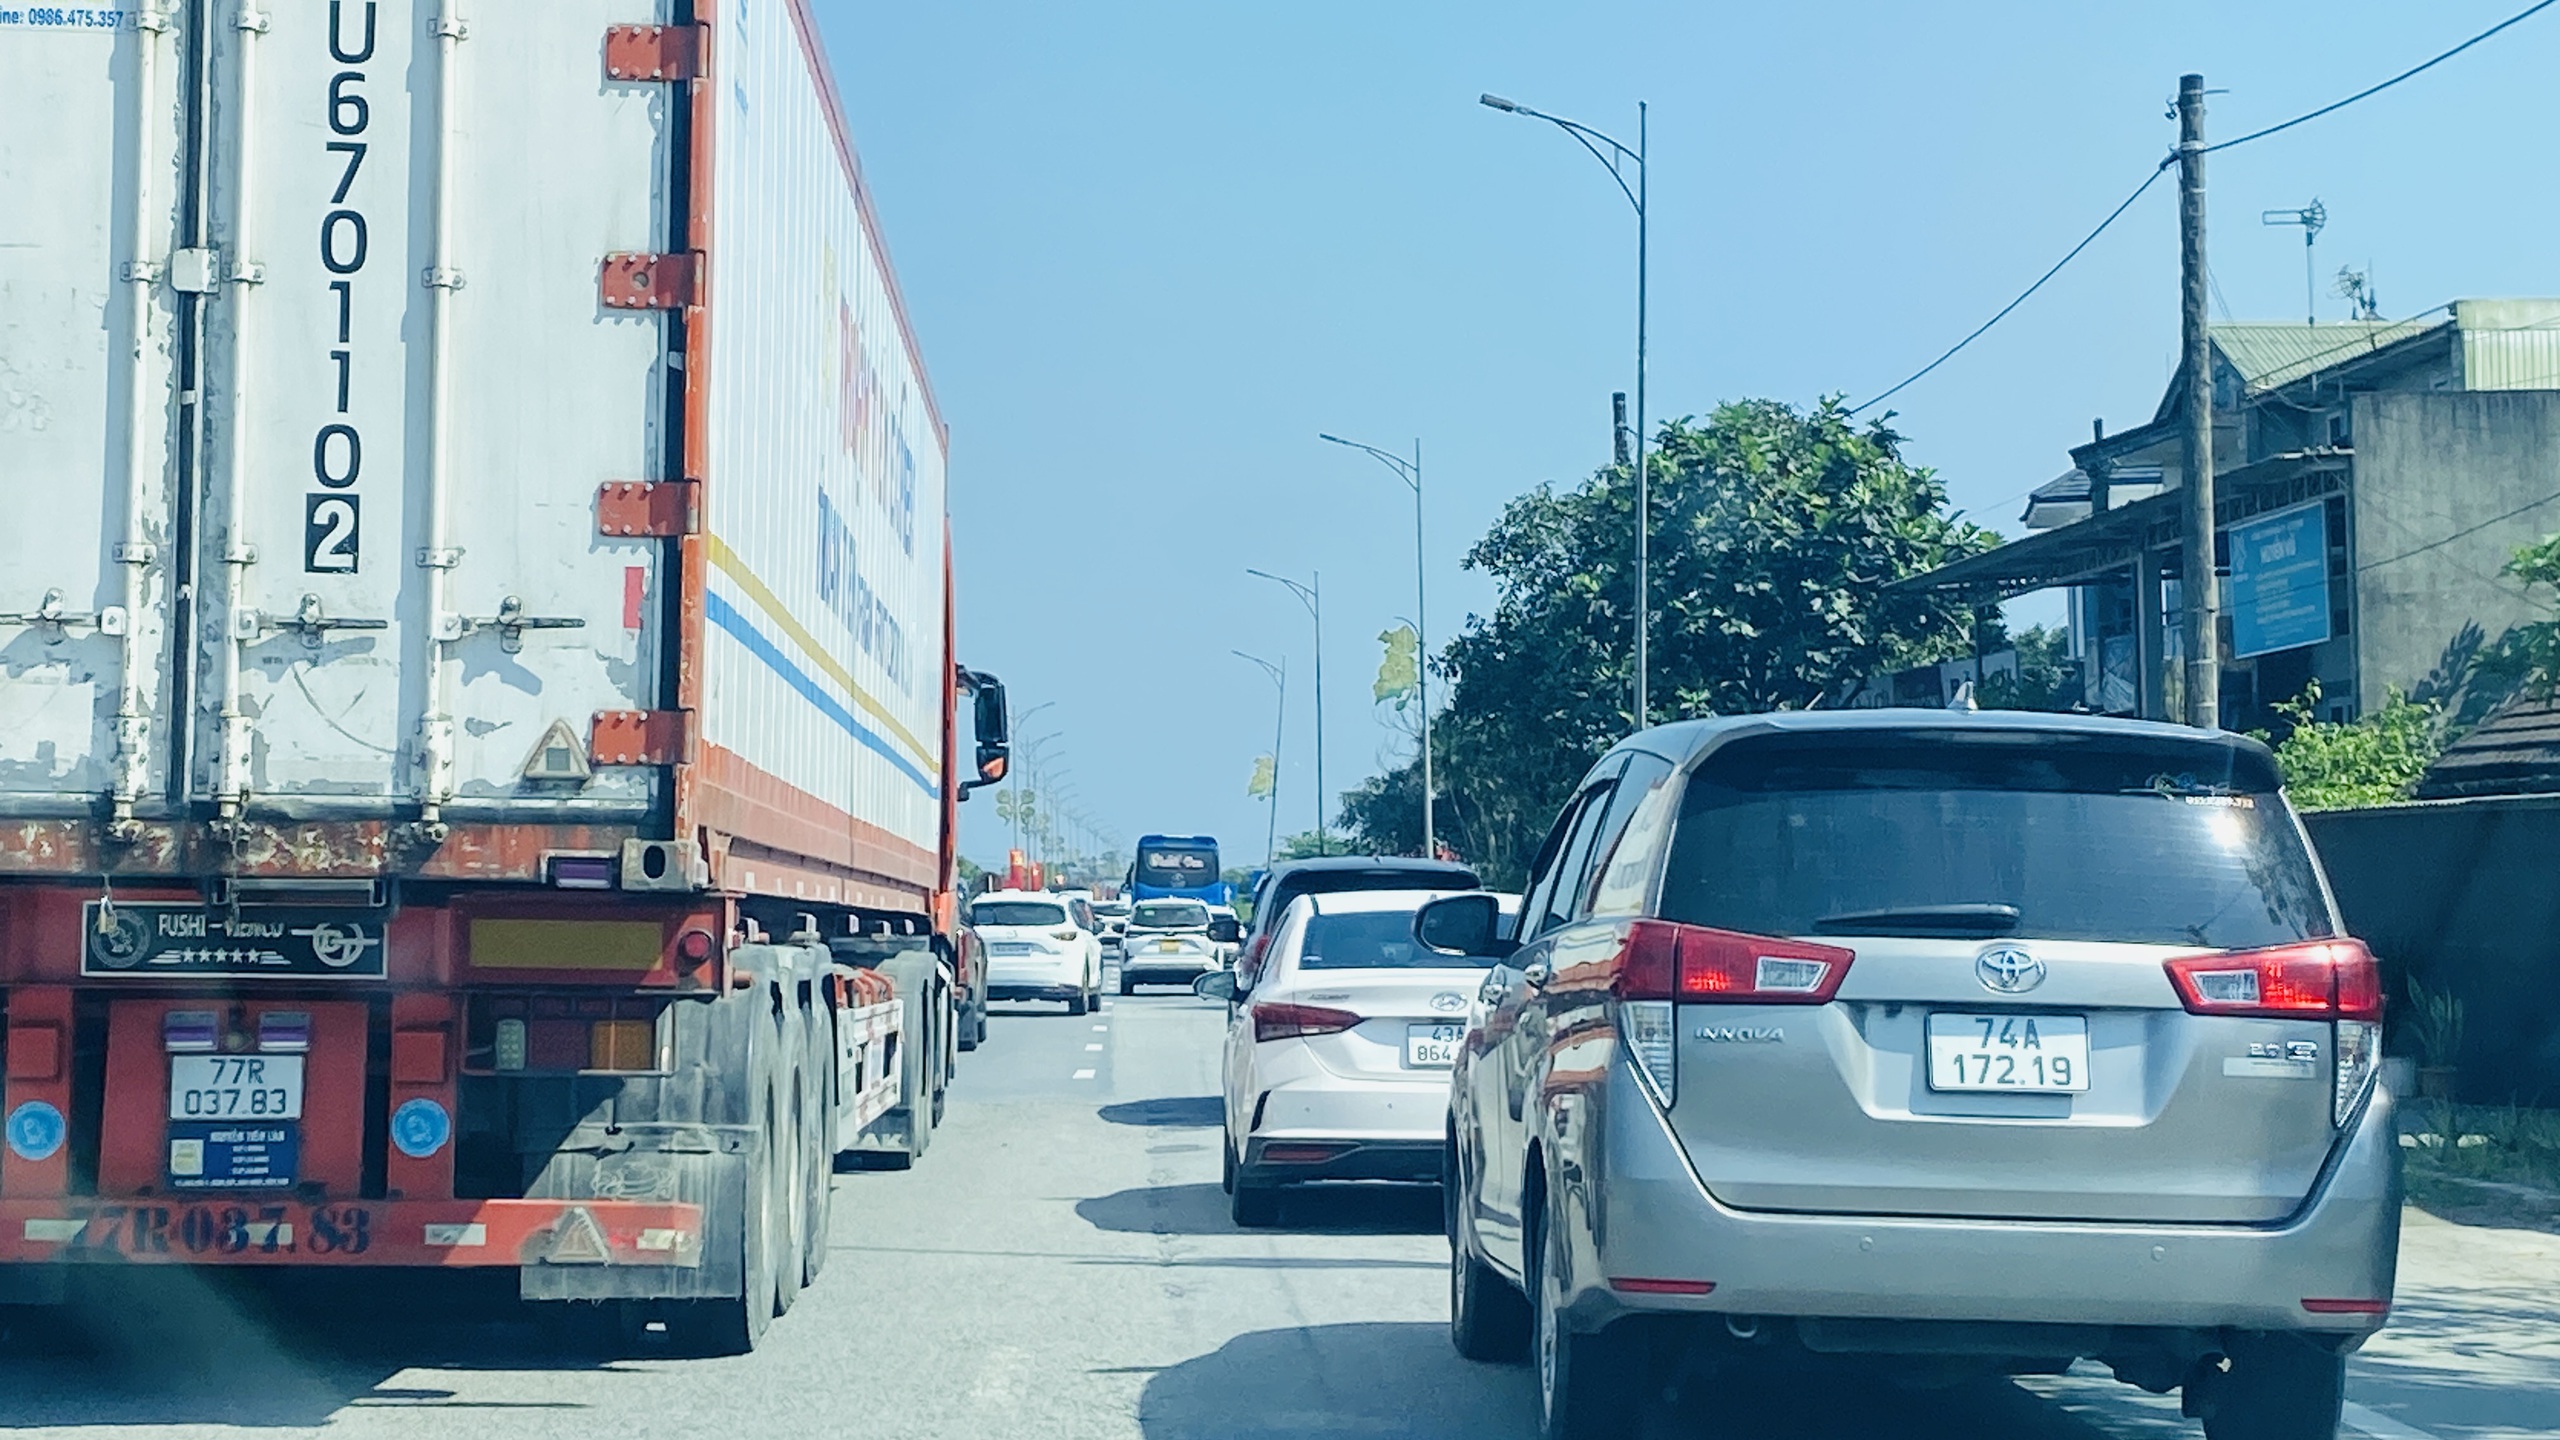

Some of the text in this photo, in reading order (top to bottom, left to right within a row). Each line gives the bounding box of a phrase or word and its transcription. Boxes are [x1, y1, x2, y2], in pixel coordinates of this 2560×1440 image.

[1695, 1026, 1784, 1042] INNOVA
[1975, 1018, 2042, 1049] 74A
[209, 1058, 265, 1084] 77R
[1953, 1054, 2072, 1086] 172.19
[184, 1088, 287, 1115] 037.83
